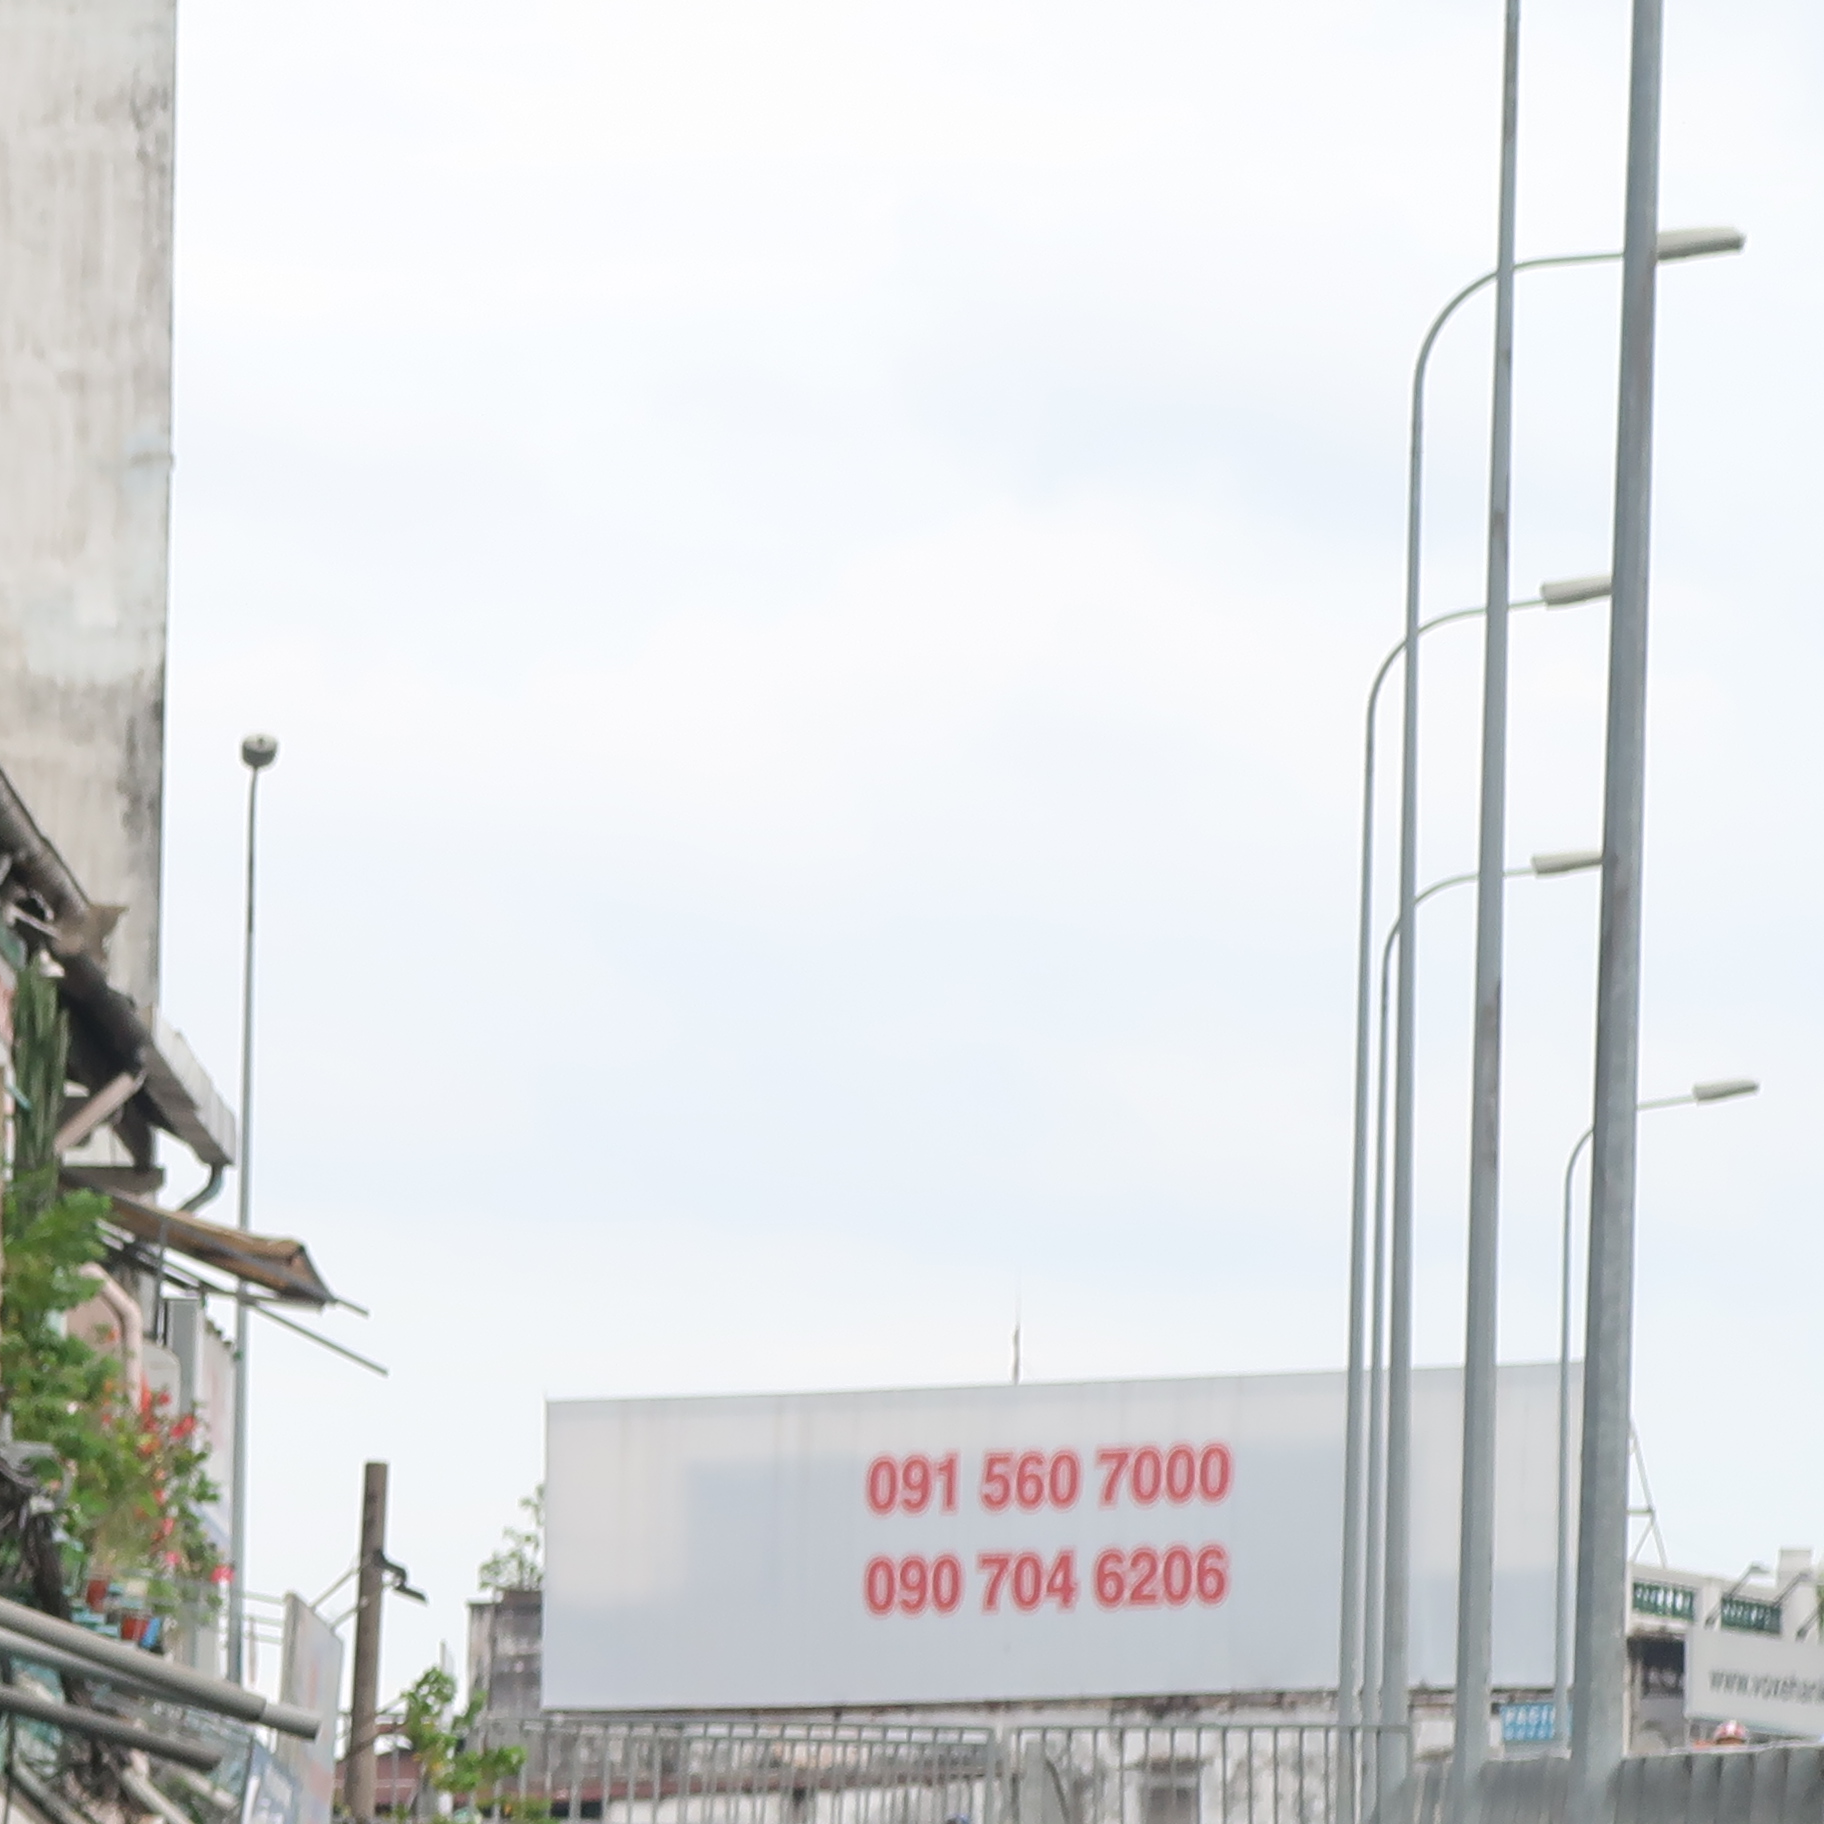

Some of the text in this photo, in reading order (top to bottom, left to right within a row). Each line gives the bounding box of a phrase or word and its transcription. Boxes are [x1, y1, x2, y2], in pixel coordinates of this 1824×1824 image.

[865, 1440, 1234, 1517] 091 560 7000
[863, 1541, 1230, 1619] 090 704 6206
